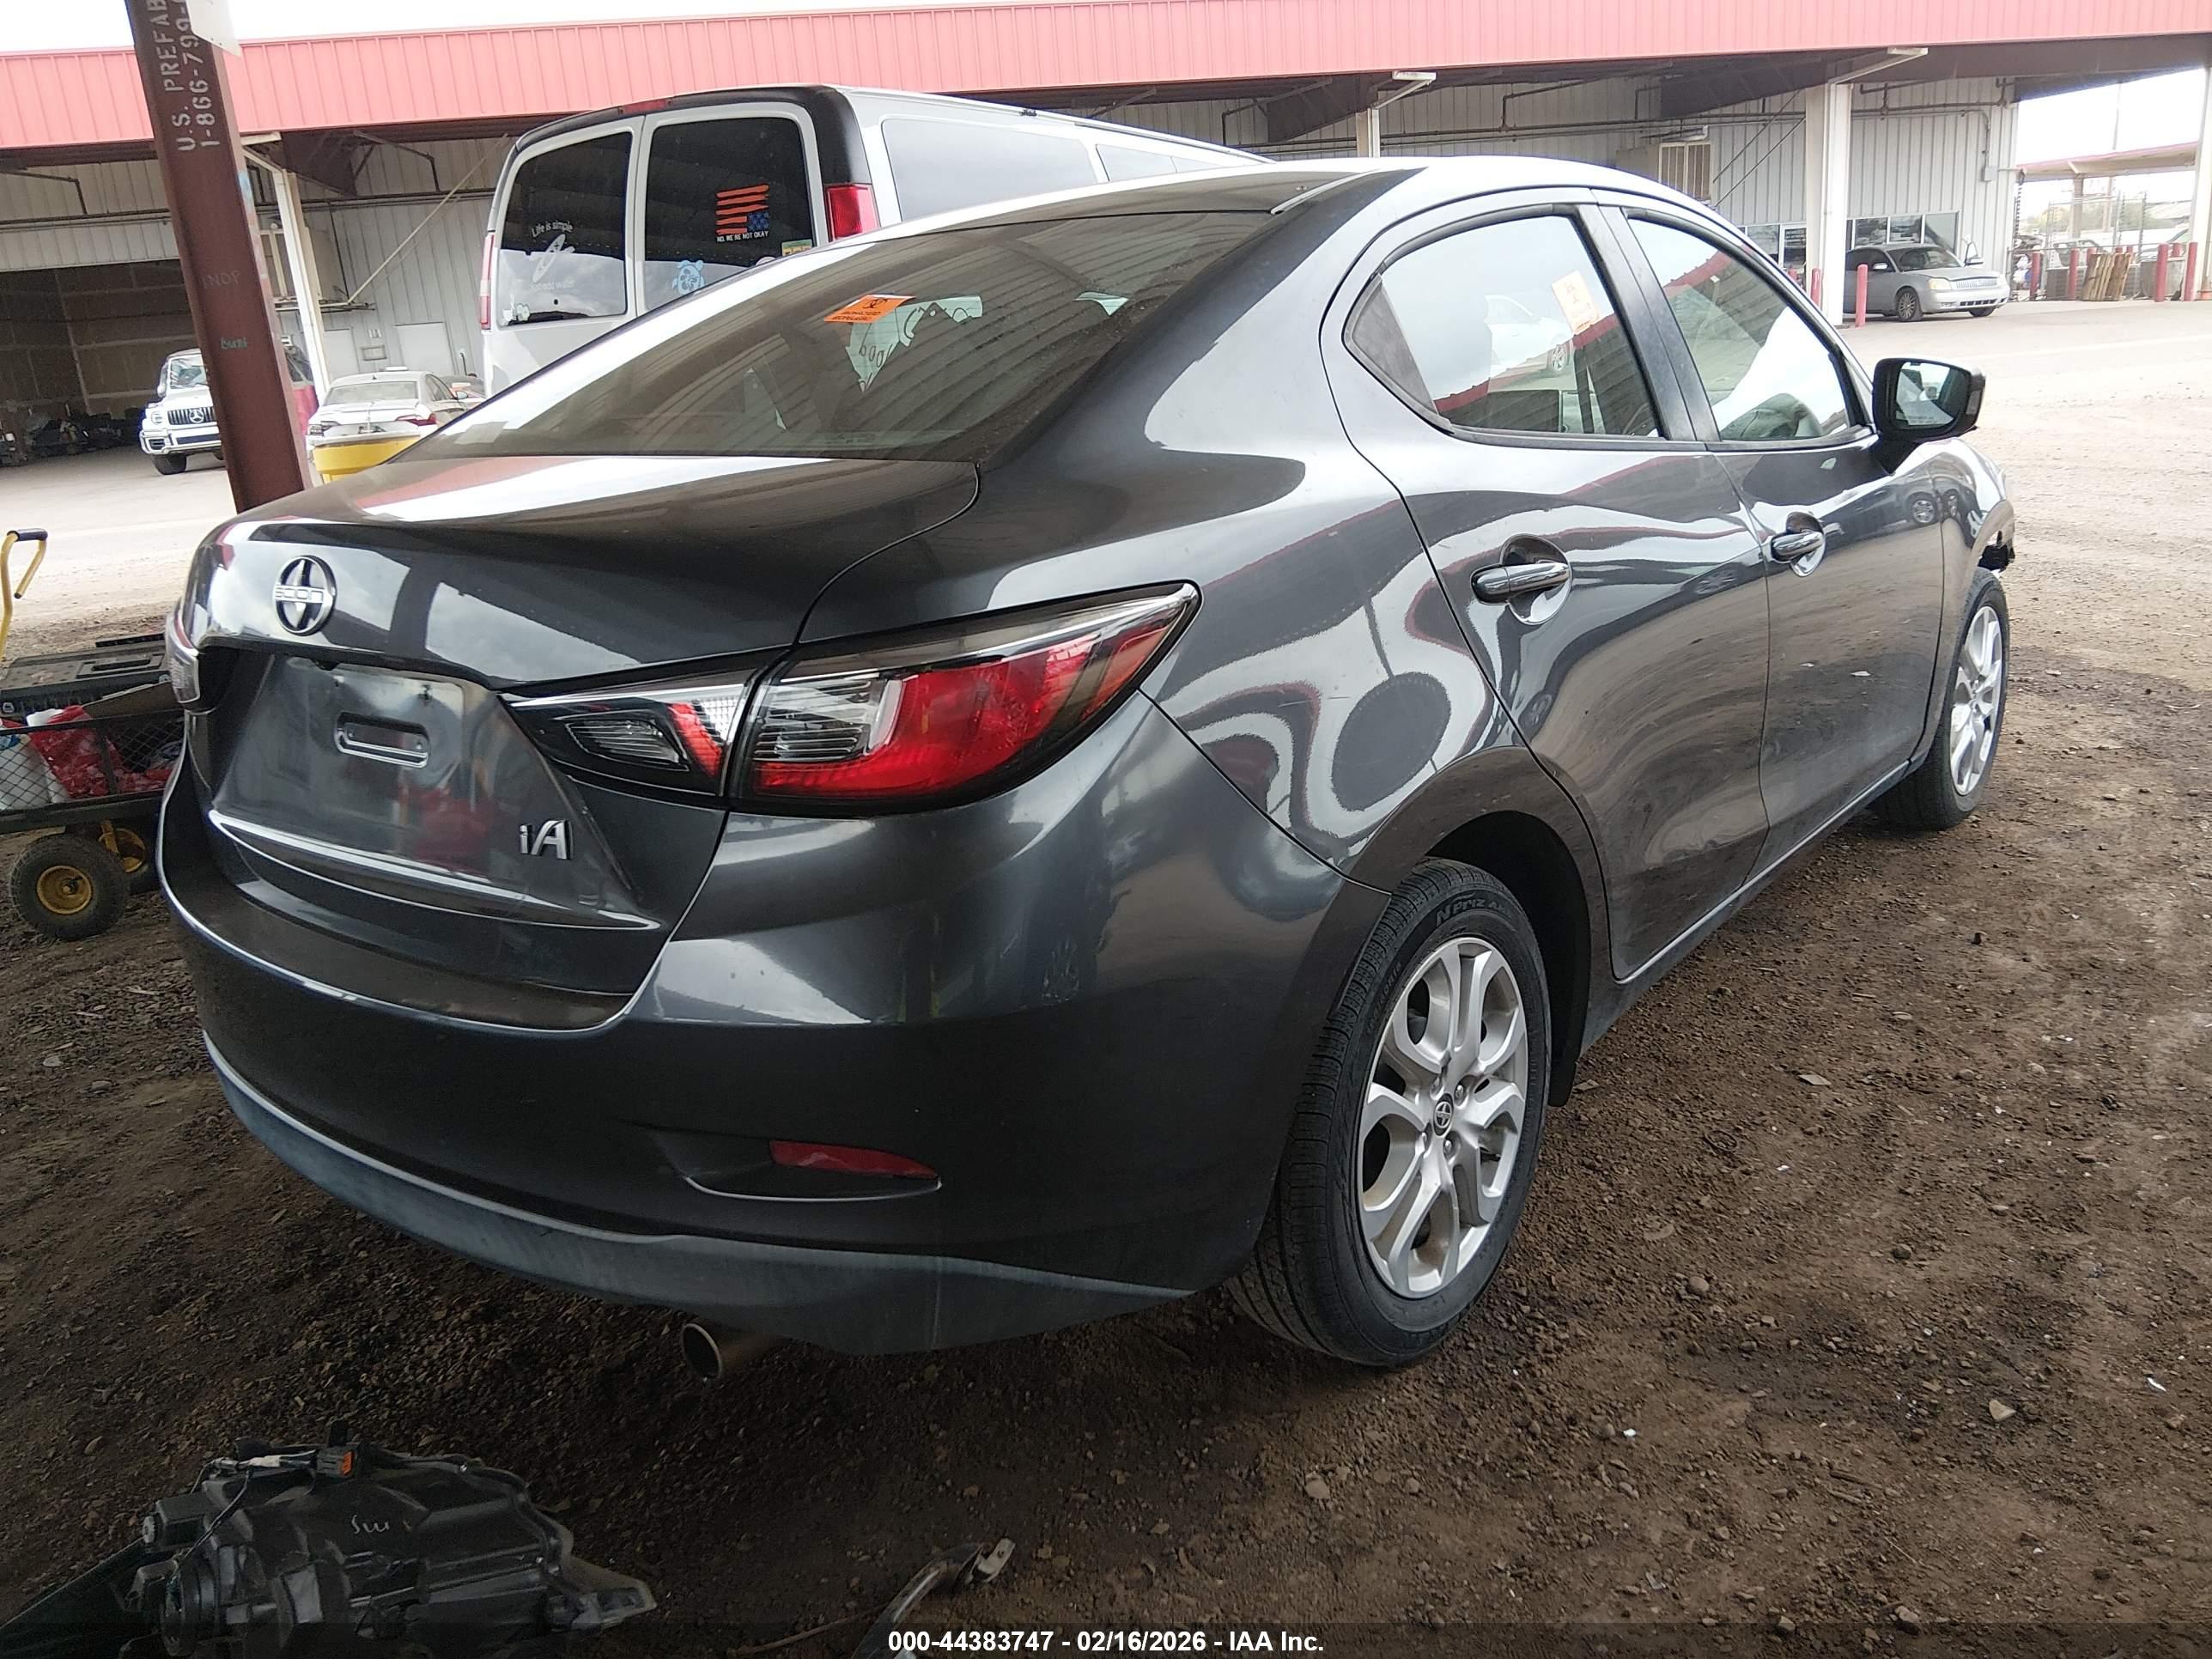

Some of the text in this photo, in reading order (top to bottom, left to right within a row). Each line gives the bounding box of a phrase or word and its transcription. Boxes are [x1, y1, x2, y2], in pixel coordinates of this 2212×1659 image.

[147, 0, 197, 151] U.S. PREFAB
[175, 0, 221, 148] 1-866-799-
[532, 220, 574, 237] Life is simple
[520, 819, 568, 860] iA
